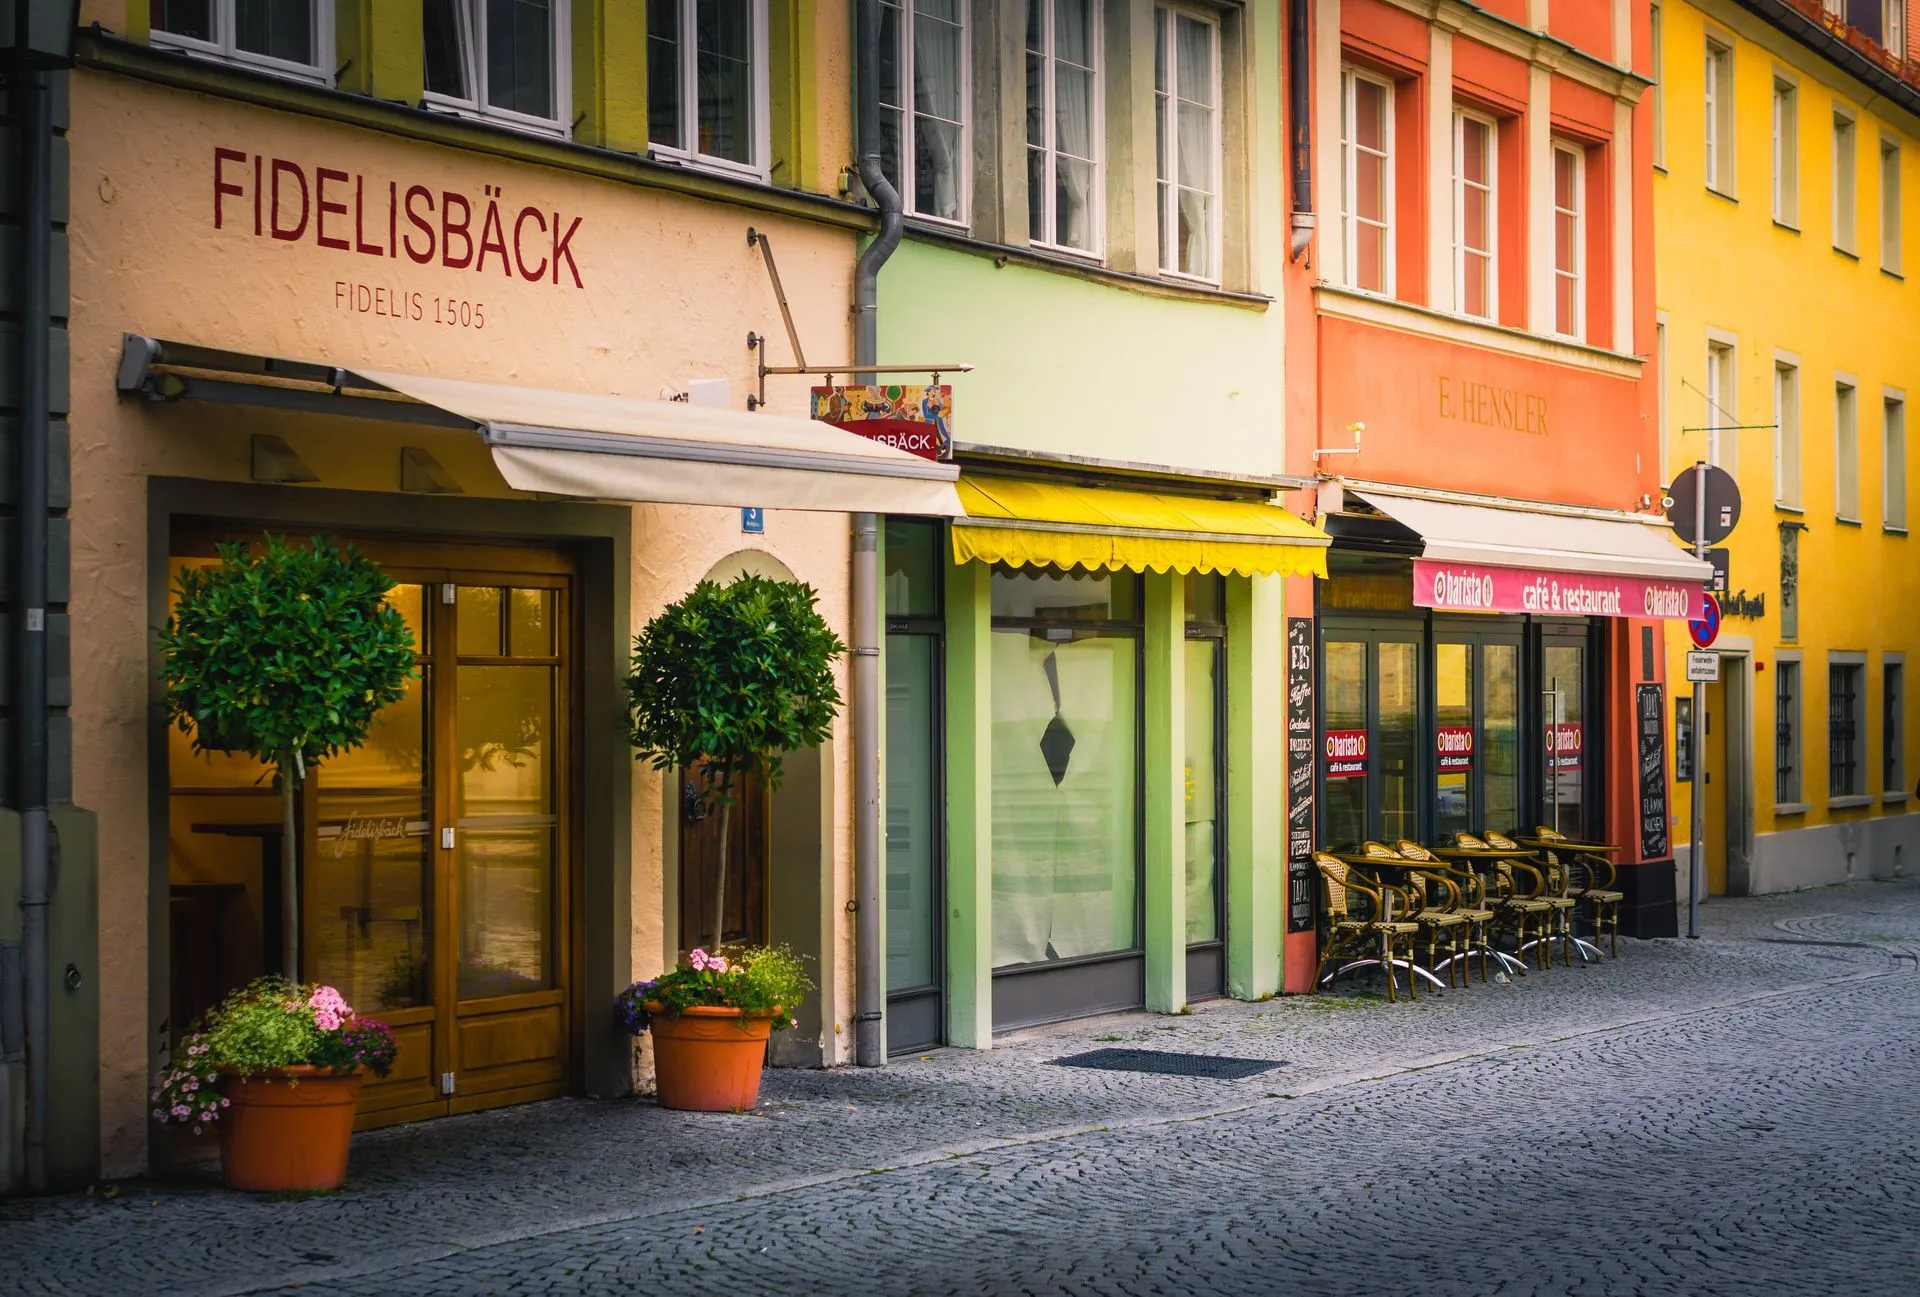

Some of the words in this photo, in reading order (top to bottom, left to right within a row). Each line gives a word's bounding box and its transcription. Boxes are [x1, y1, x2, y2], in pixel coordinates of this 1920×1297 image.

[214, 147, 584, 289] FIDELISBÄCK
[335, 281, 423, 321] FIDELIS
[434, 297, 485, 329] 1505
[1438, 376, 1456, 419] E.
[1461, 380, 1549, 437] HENSLER
[1447, 570, 1482, 607] barista
[1523, 577, 1549, 611] café
[1551, 583, 1561, 611] &
[1563, 586, 1621, 614] restaurant
[1653, 586, 1679, 617] barista
[1334, 734, 1358, 757] barista
[1445, 730, 1465, 751] barista
